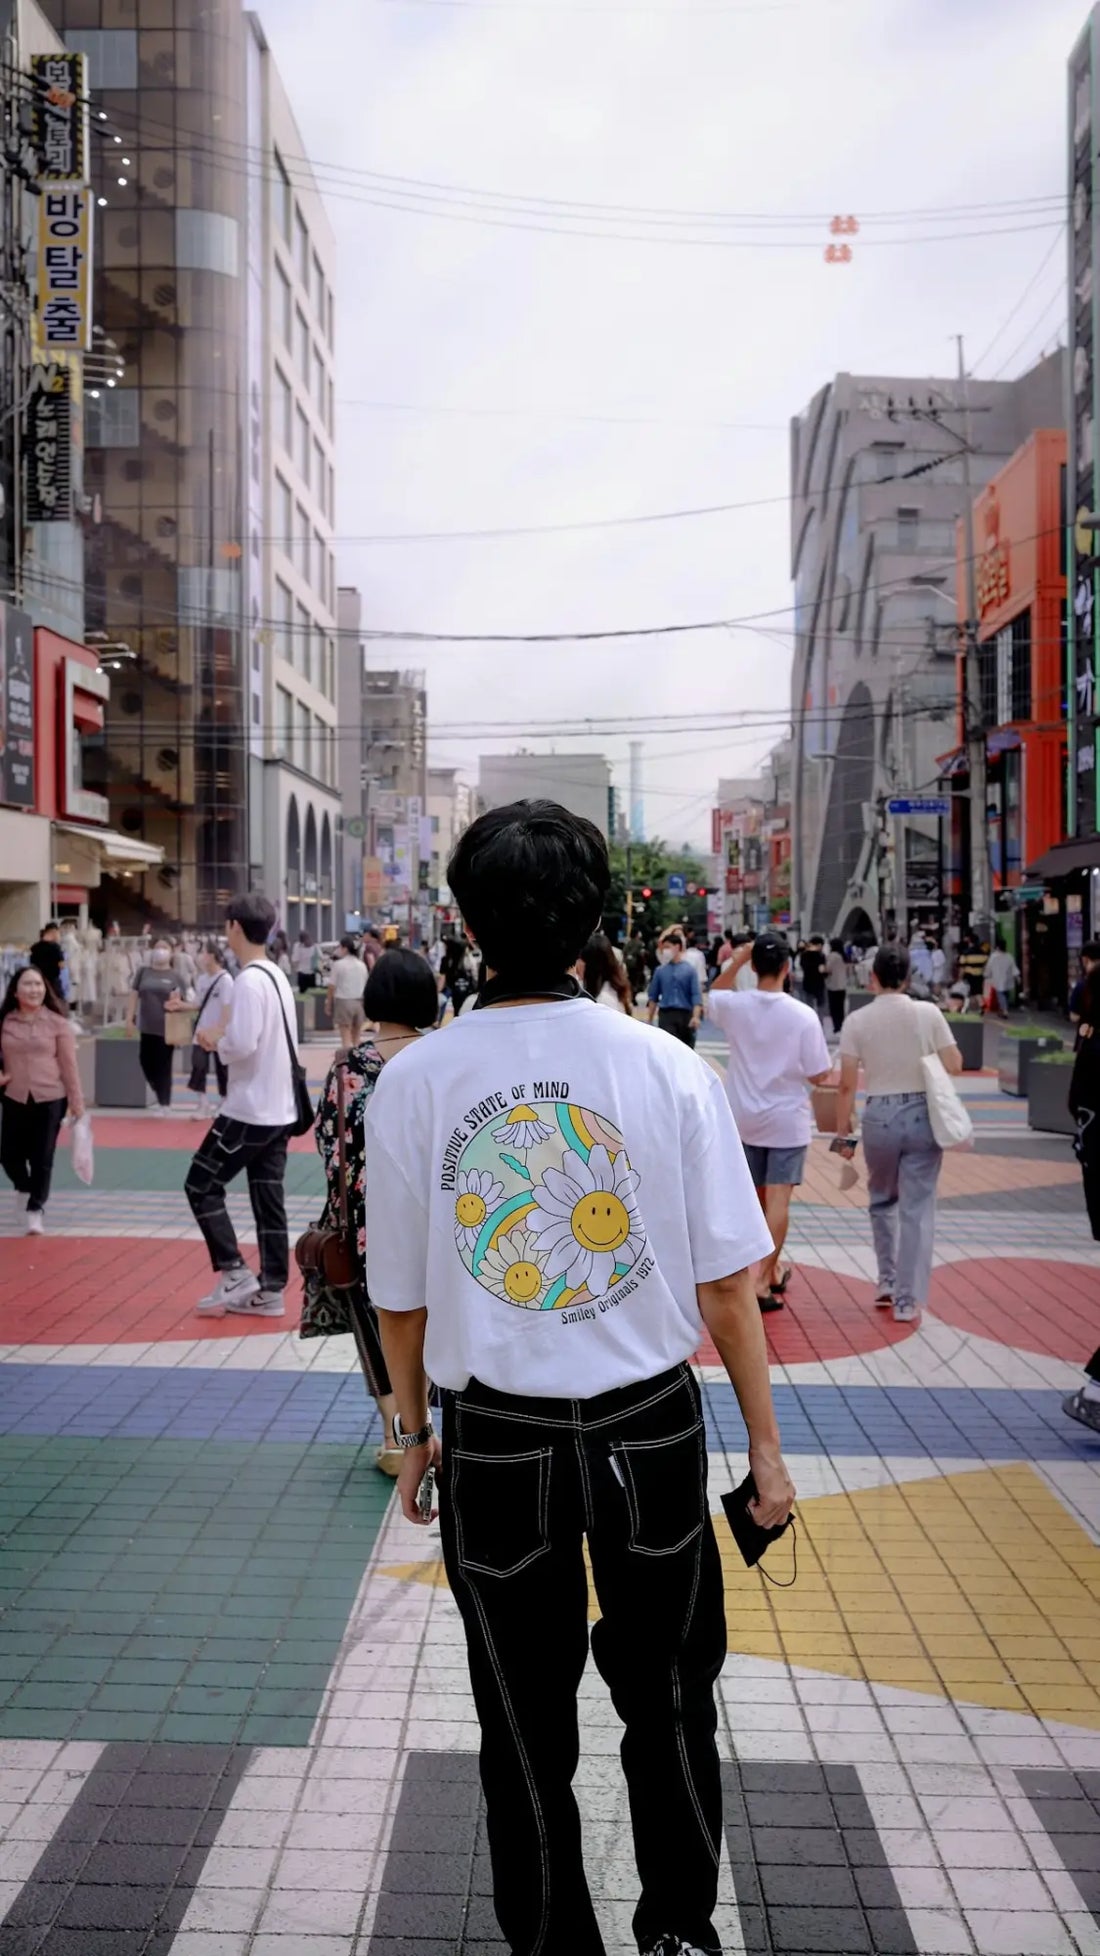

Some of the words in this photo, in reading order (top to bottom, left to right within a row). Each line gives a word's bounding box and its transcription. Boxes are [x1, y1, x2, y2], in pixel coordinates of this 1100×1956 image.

[43, 194, 84, 341] 방탈출
[35, 395, 59, 507] 노래연습장
[440, 1128, 468, 1191] POSITIVE
[463, 1091, 508, 1130] STATE
[511, 1084, 526, 1100] OF
[533, 1081, 570, 1099] MIND
[561, 1307, 597, 1325] Smiley
[598, 1279, 639, 1313] Originals
[635, 1257, 655, 1280] 1972
